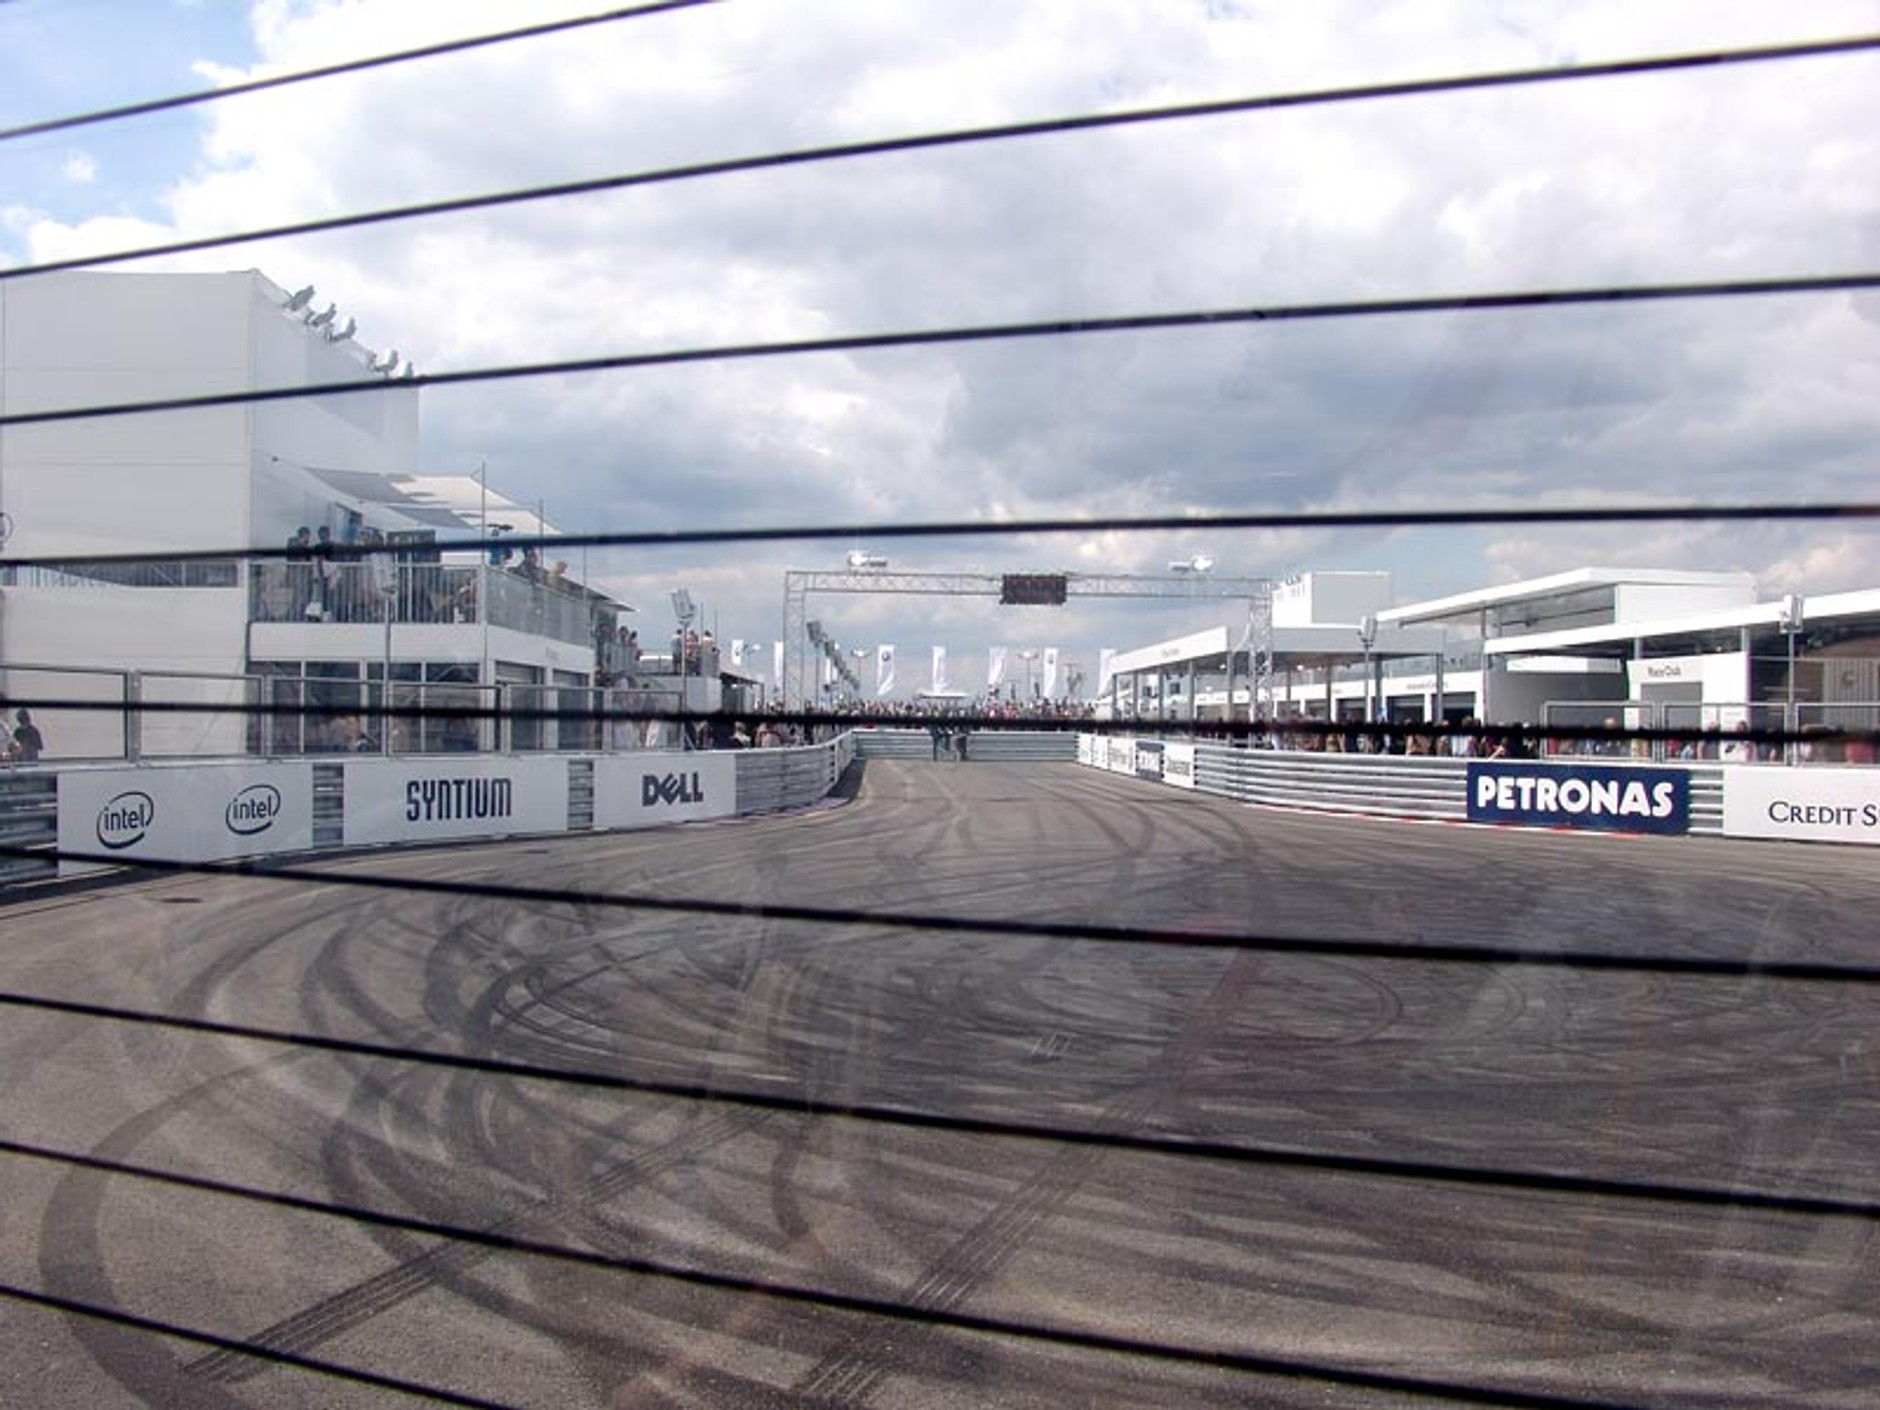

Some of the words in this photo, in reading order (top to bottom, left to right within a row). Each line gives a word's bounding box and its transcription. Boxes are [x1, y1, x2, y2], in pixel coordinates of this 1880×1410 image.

[407, 778, 511, 822] SYNTIUM
[642, 771, 703, 807] DELL
[1477, 776, 1674, 818] PETRONAS
[103, 804, 144, 832] intel
[232, 796, 272, 820] intel
[1768, 801, 1857, 825] CREDIT
[1862, 804, 1880, 826] S
